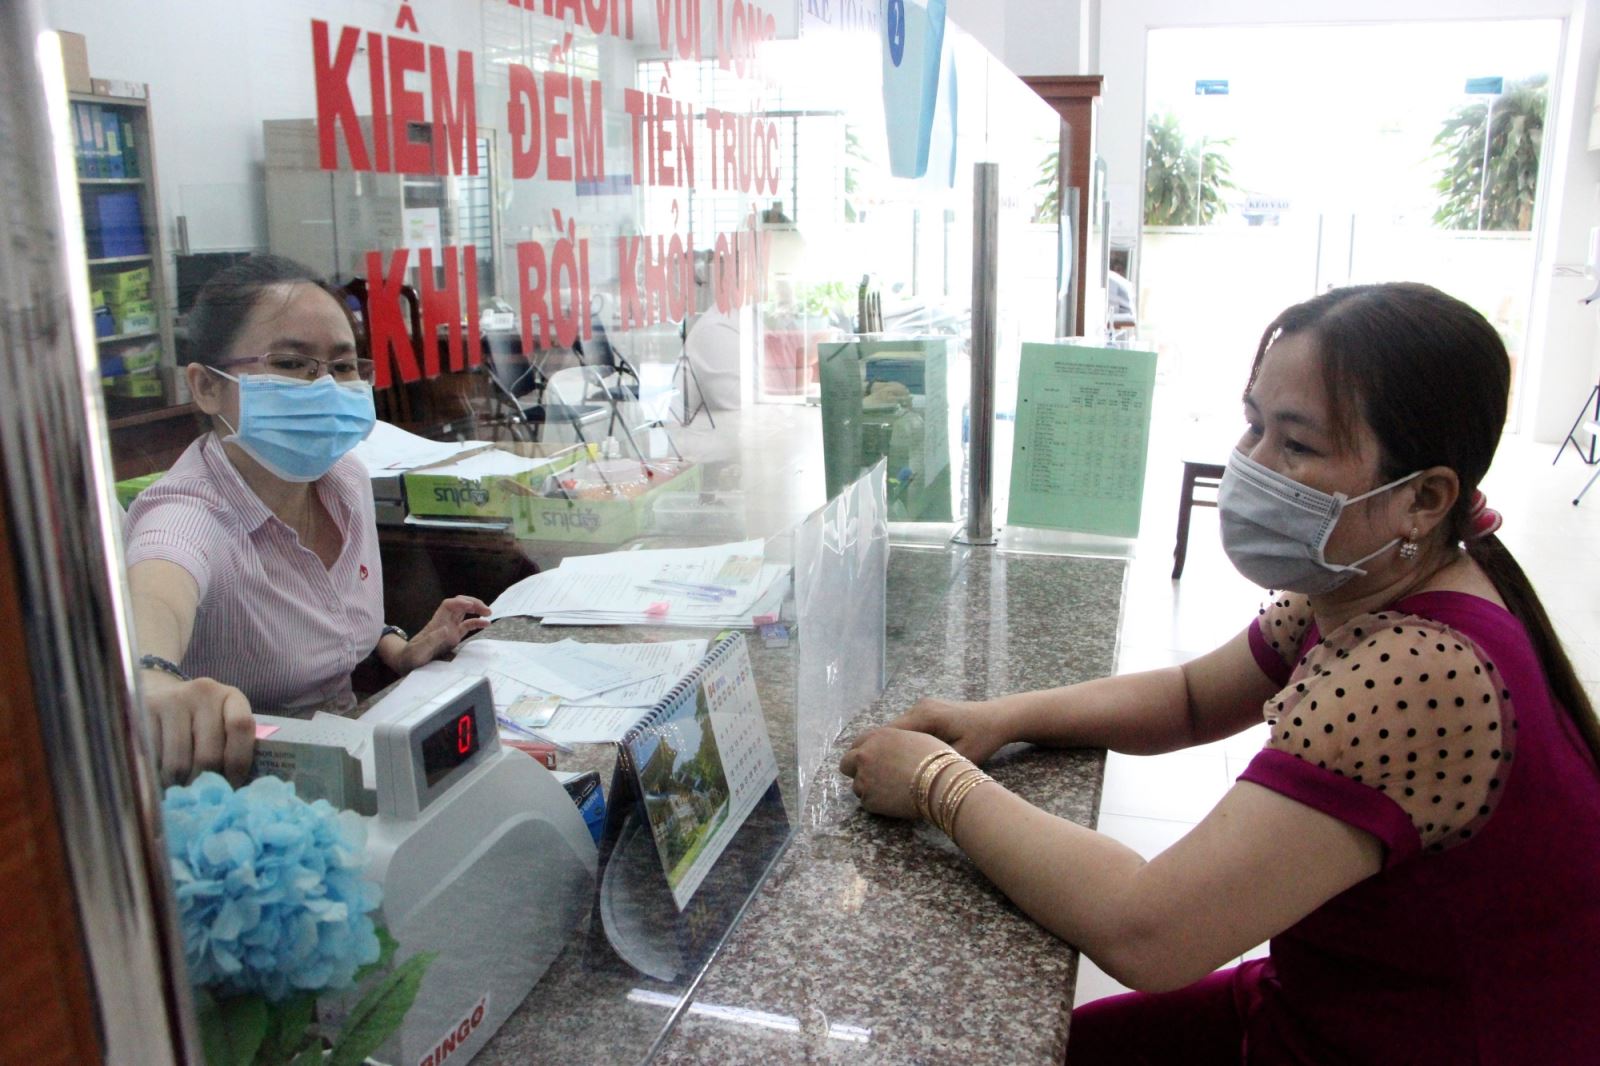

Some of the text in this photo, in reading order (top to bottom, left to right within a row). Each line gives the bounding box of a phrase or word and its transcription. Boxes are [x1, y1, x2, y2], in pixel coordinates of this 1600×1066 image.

[507, 32, 605, 182] ĐẾM
[624, 61, 695, 188] TIỀN
[366, 244, 482, 390] KHI
[516, 208, 593, 357] RỜI
[618, 199, 697, 332] KHỎI
[457, 714, 471, 753] 0
